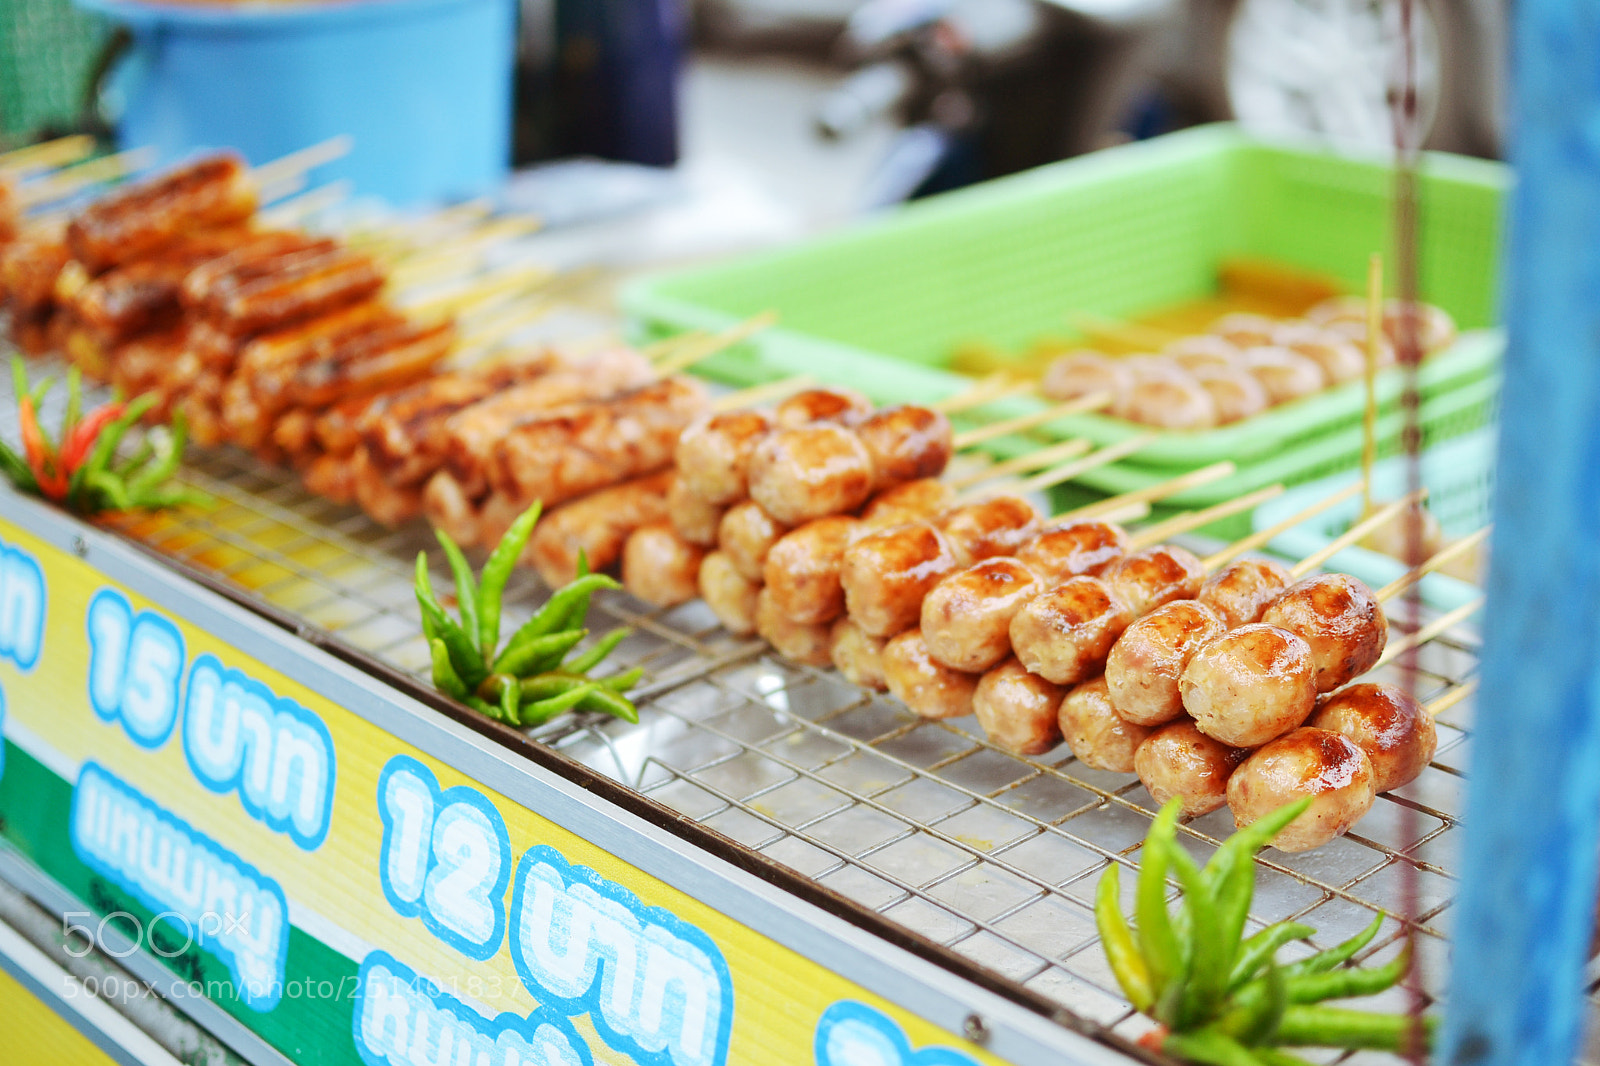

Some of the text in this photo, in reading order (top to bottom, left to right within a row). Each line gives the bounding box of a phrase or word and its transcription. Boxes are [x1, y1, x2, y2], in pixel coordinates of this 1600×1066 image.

[91, 596, 180, 741] 15
[189, 661, 331, 842] บาท
[384, 769, 503, 947] 12
[518, 860, 722, 1063] บาท
